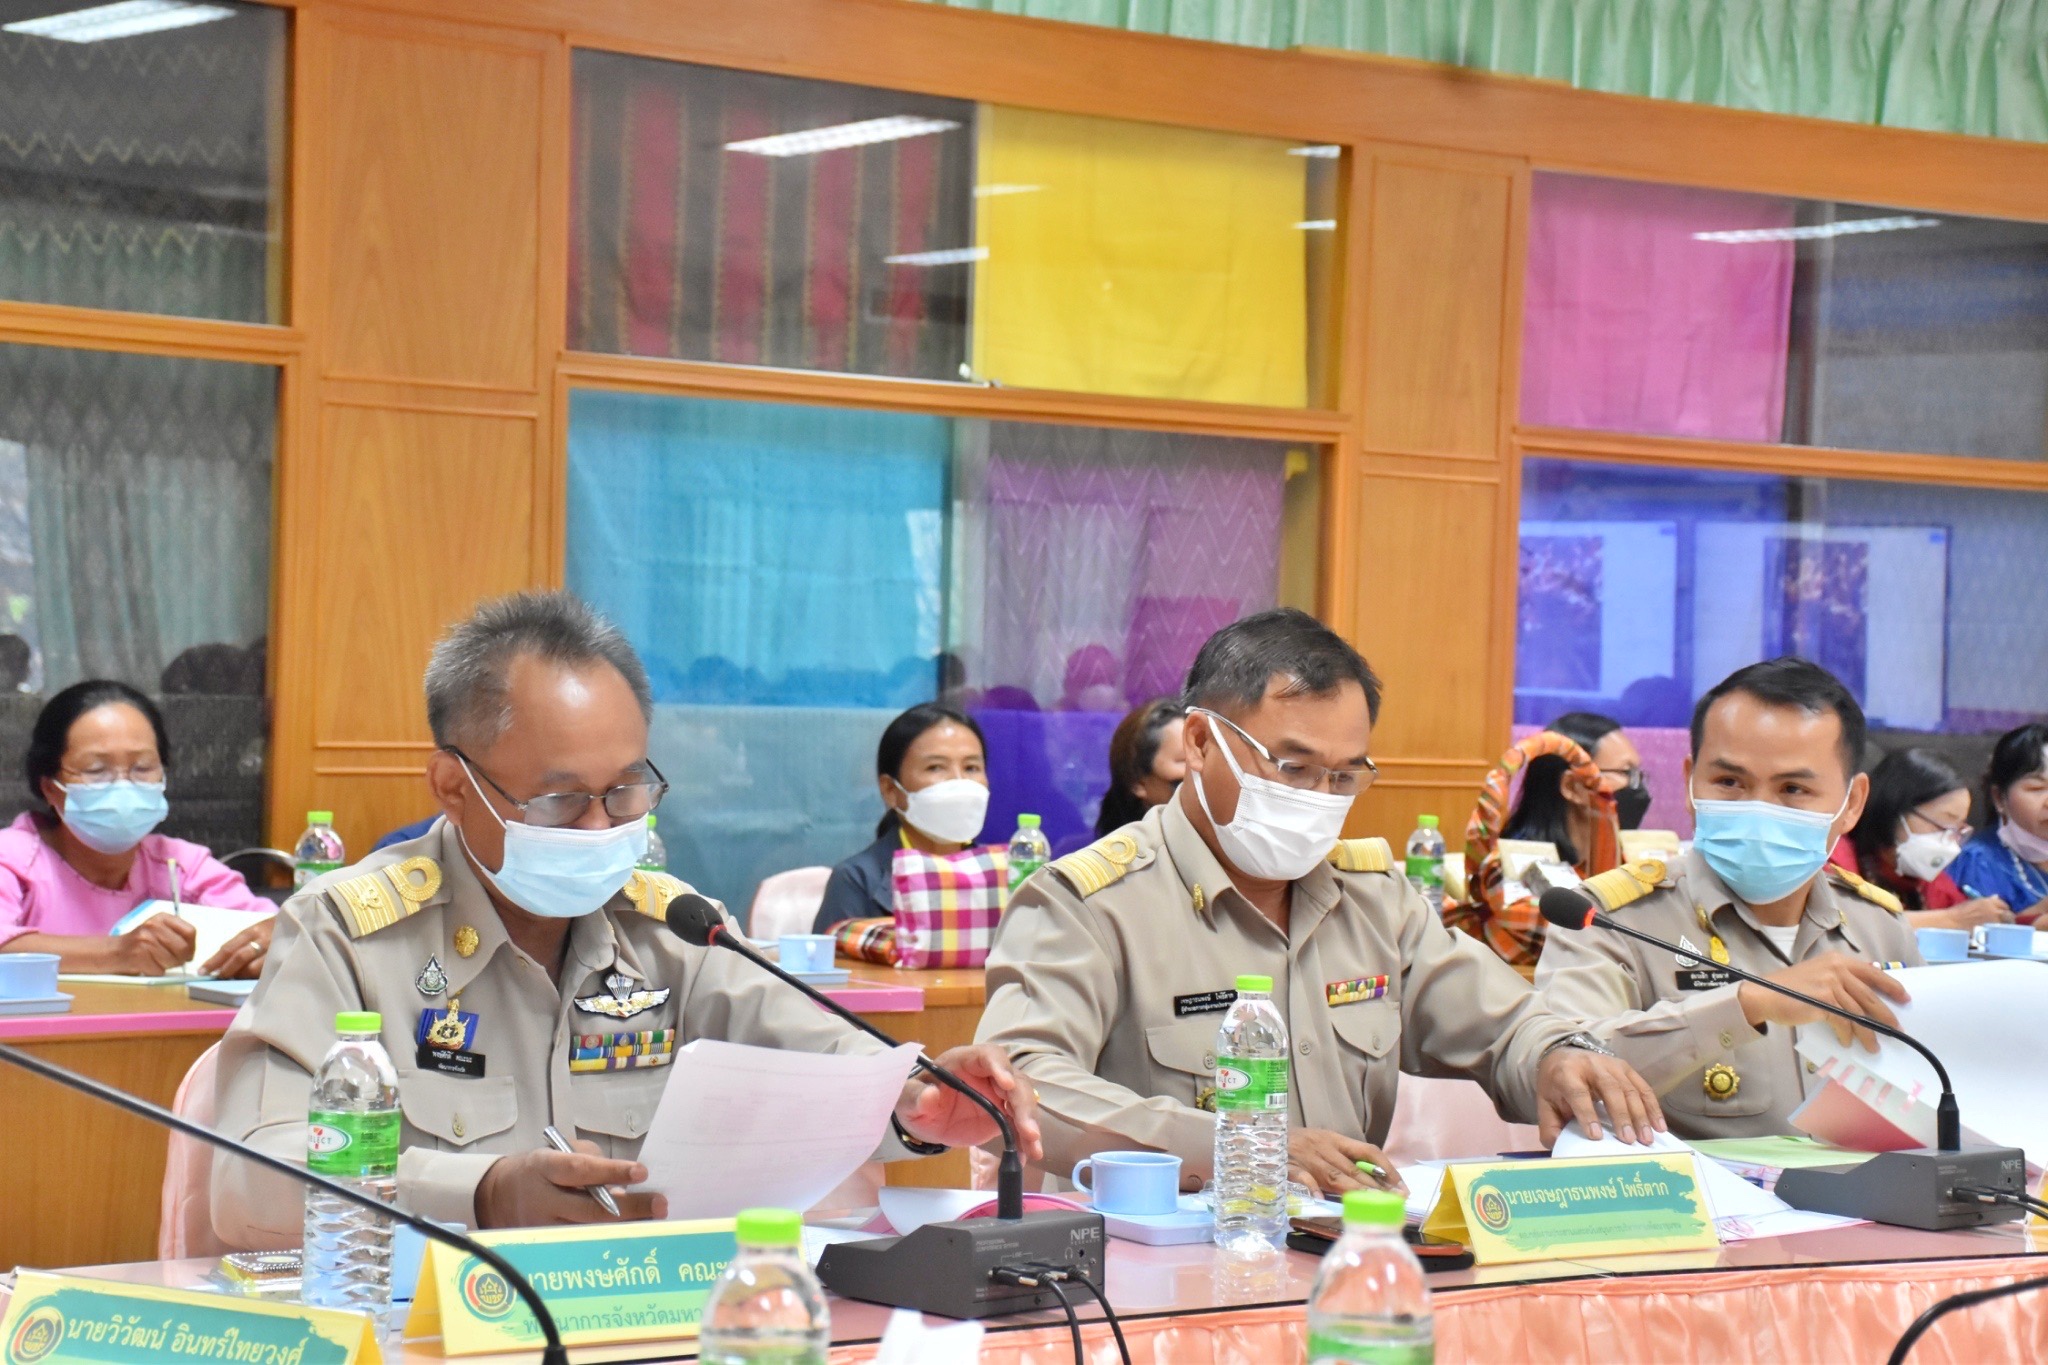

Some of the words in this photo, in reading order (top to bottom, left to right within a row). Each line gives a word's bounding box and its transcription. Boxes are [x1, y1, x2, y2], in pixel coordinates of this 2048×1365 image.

[2001, 1159, 2022, 1170] NPE
[1616, 1171, 1670, 1199] โพธิ์ตาก
[1070, 1226, 1100, 1241] NPE
[66, 1313, 172, 1351] นายวิวัฒน์
[522, 1303, 704, 1335] พันาการจังหวัดมหา
